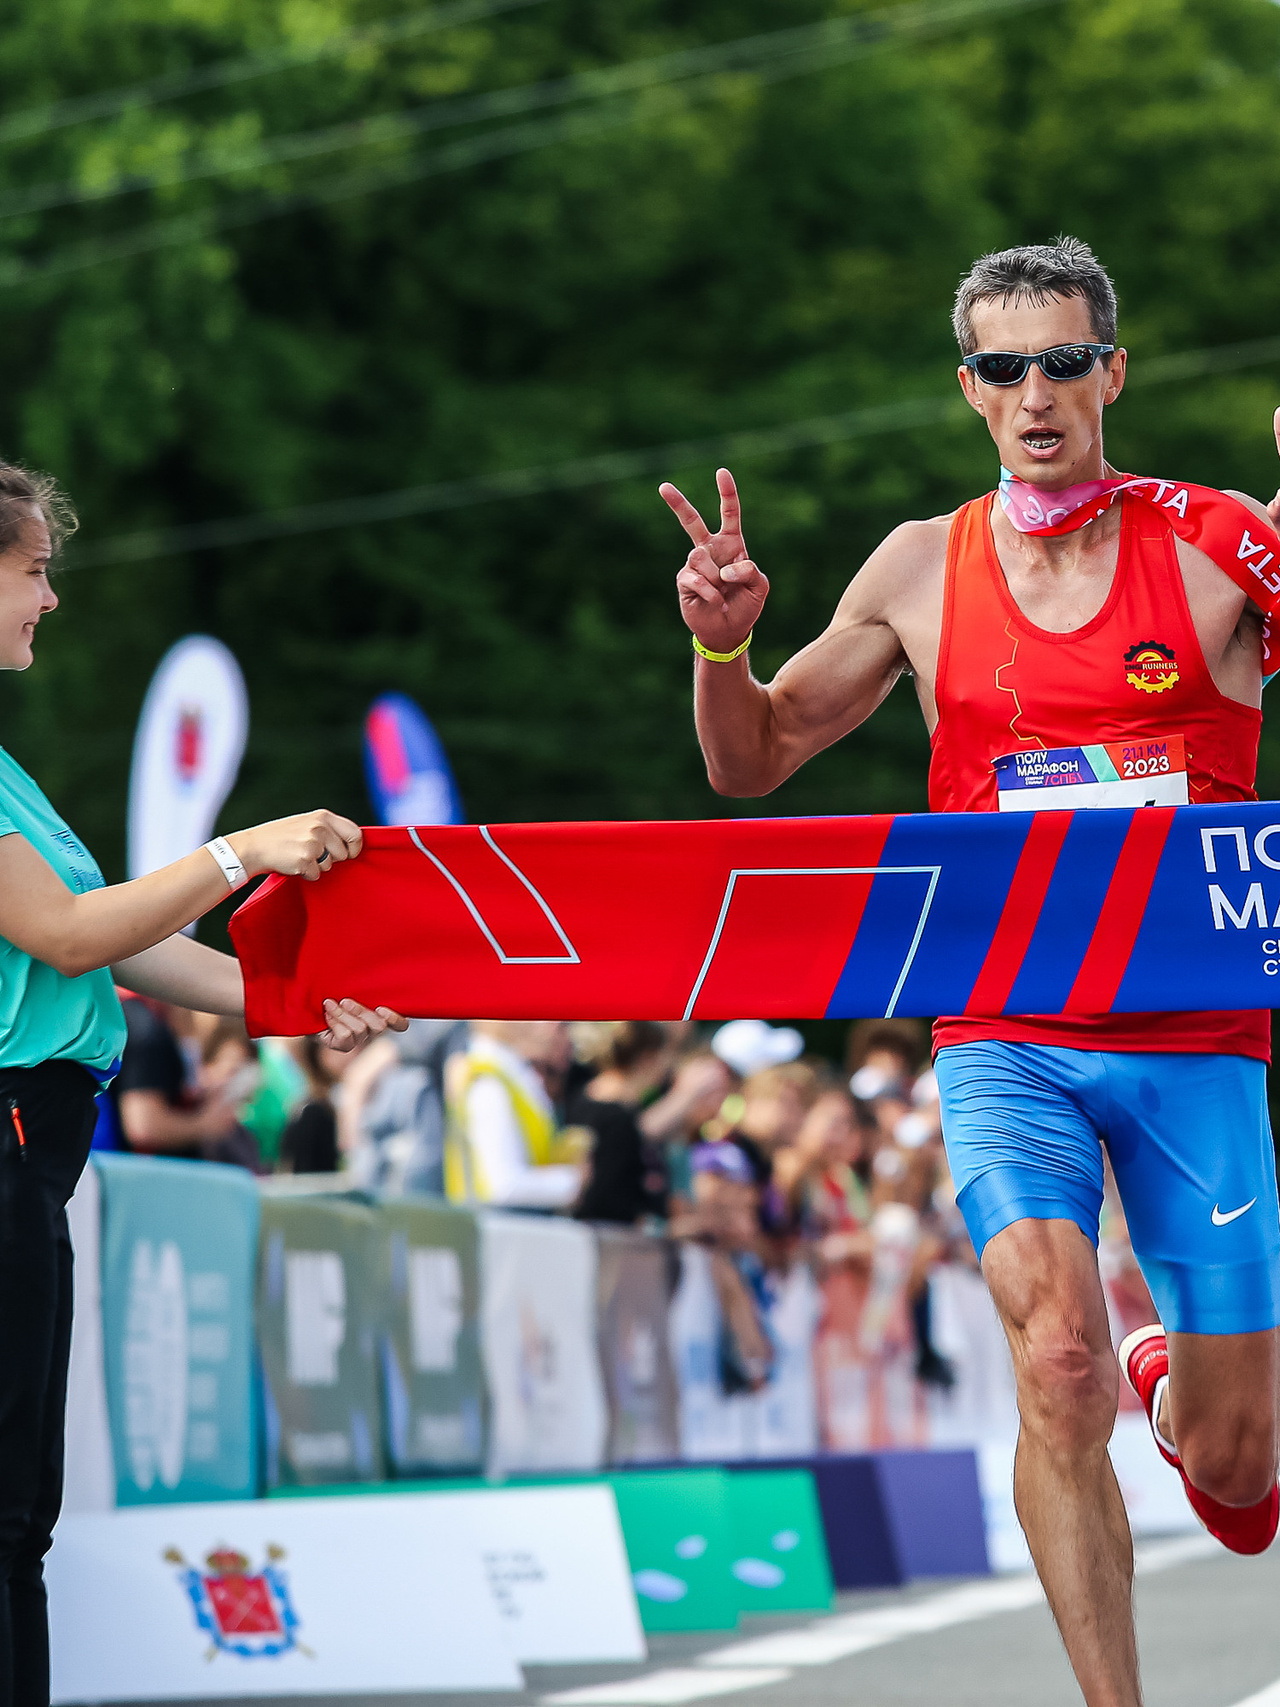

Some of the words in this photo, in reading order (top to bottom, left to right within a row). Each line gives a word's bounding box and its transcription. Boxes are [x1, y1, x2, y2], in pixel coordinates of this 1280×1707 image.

[1015, 751, 1048, 765] ПОЛУ
[1123, 755, 1170, 777] 2023
[1017, 760, 1079, 777] МАРАФОН
